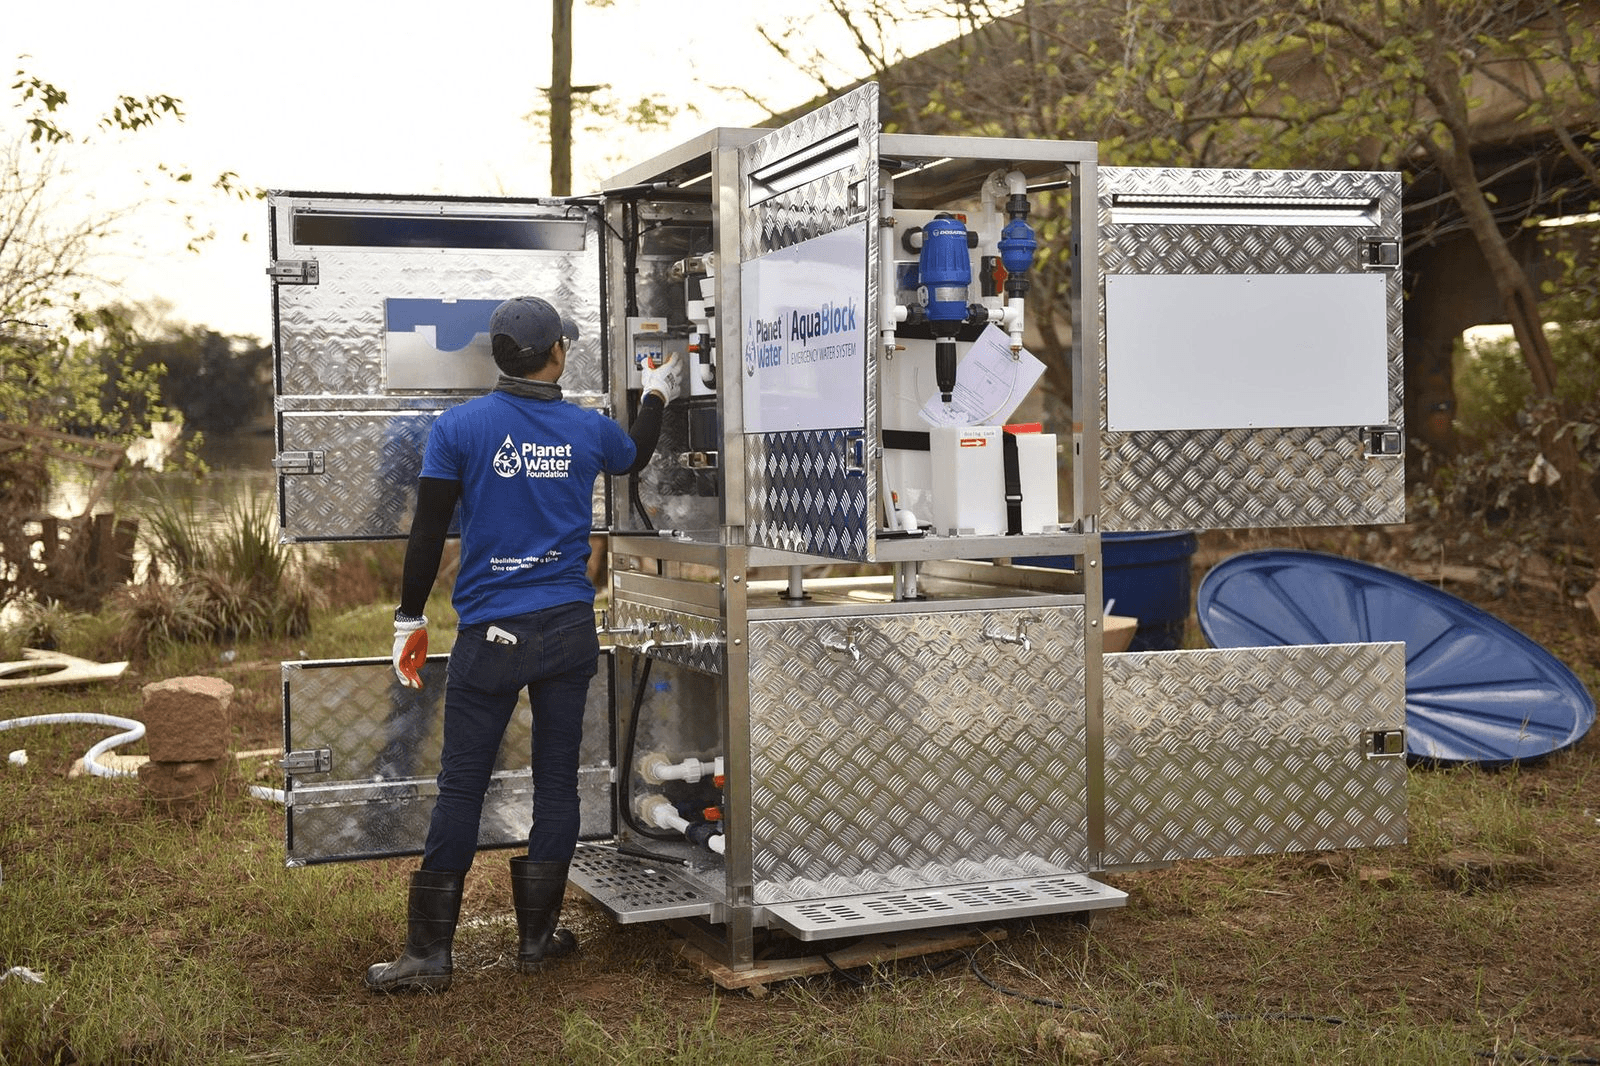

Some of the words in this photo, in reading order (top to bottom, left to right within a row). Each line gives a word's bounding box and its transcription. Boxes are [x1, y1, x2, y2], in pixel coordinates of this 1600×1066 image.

[756, 317, 782, 343] Planet
[791, 297, 856, 347] AquaBlock
[757, 344, 782, 369] Water
[836, 342, 857, 359] SYSTEM
[522, 443, 572, 457] Planet
[524, 457, 571, 471] Water
[526, 470, 569, 478] Foundation
